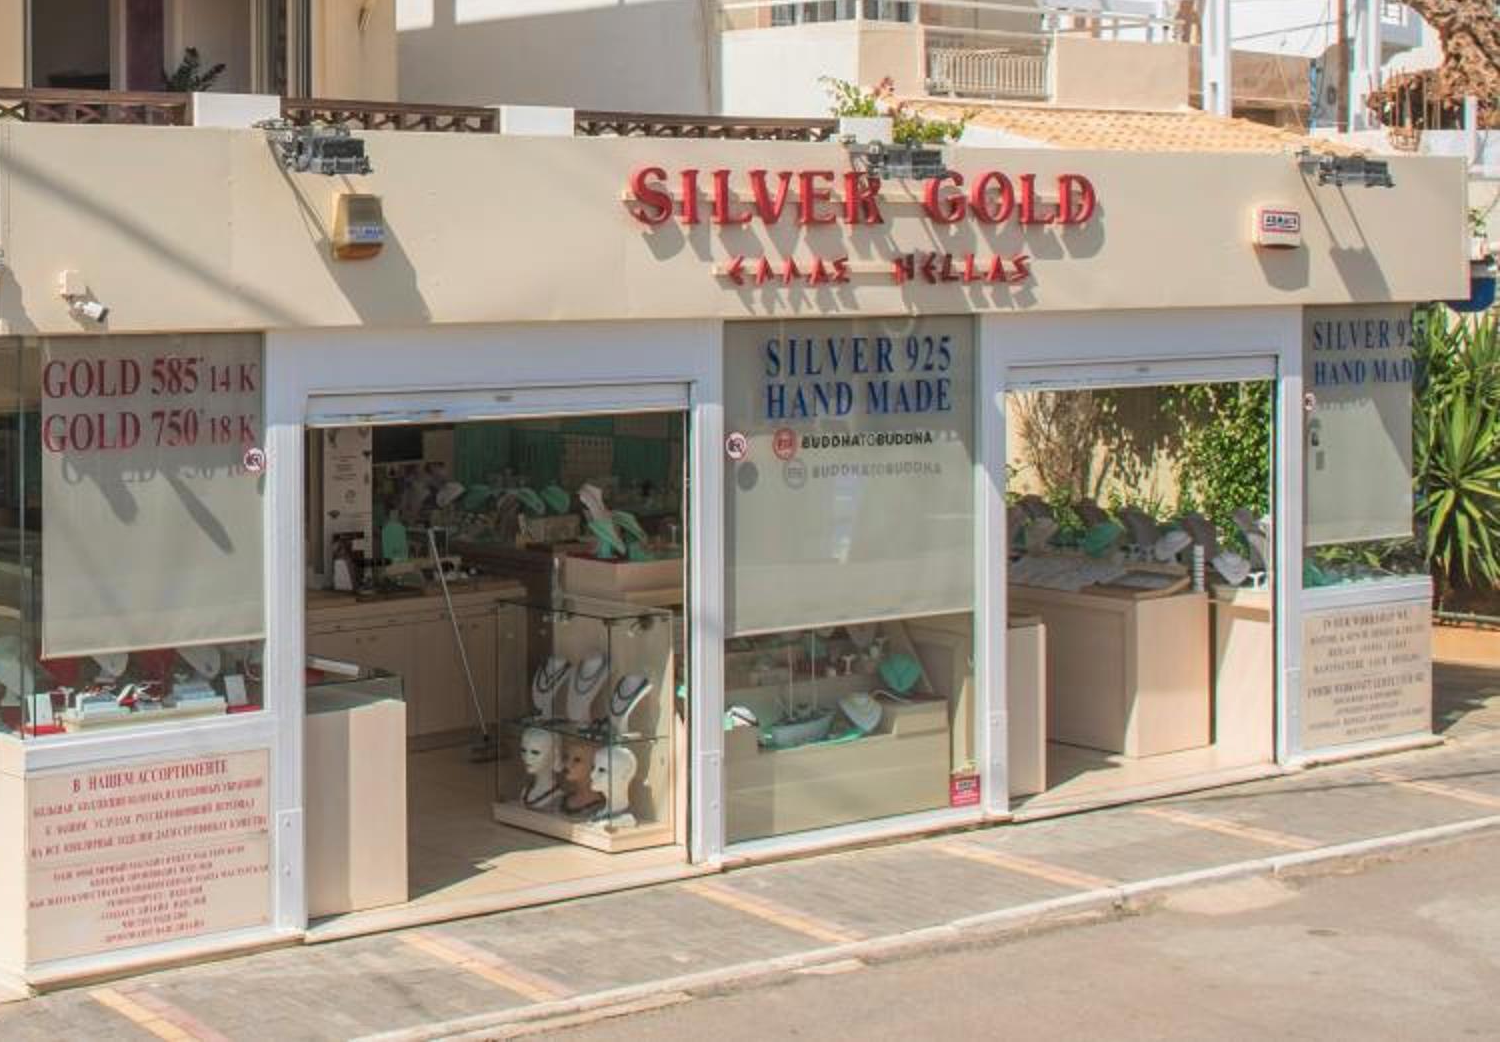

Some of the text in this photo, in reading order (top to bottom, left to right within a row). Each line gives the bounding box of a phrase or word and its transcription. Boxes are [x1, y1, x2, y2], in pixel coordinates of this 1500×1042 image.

[628, 166, 1097, 226] SILVER GOLD
[891, 253, 1030, 286] HELLAS
[1313, 319, 1390, 351] SILVER
[765, 334, 952, 379] SILVER 925
[1315, 359, 1366, 386] HAND
[43, 358, 142, 399] GOLD
[211, 365, 230, 393] 14
[239, 362, 258, 393] K
[766, 377, 953, 419] HAND MADE
[43, 411, 142, 453] GOLD
[211, 414, 231, 445] 18
[239, 414, 257, 444] K
